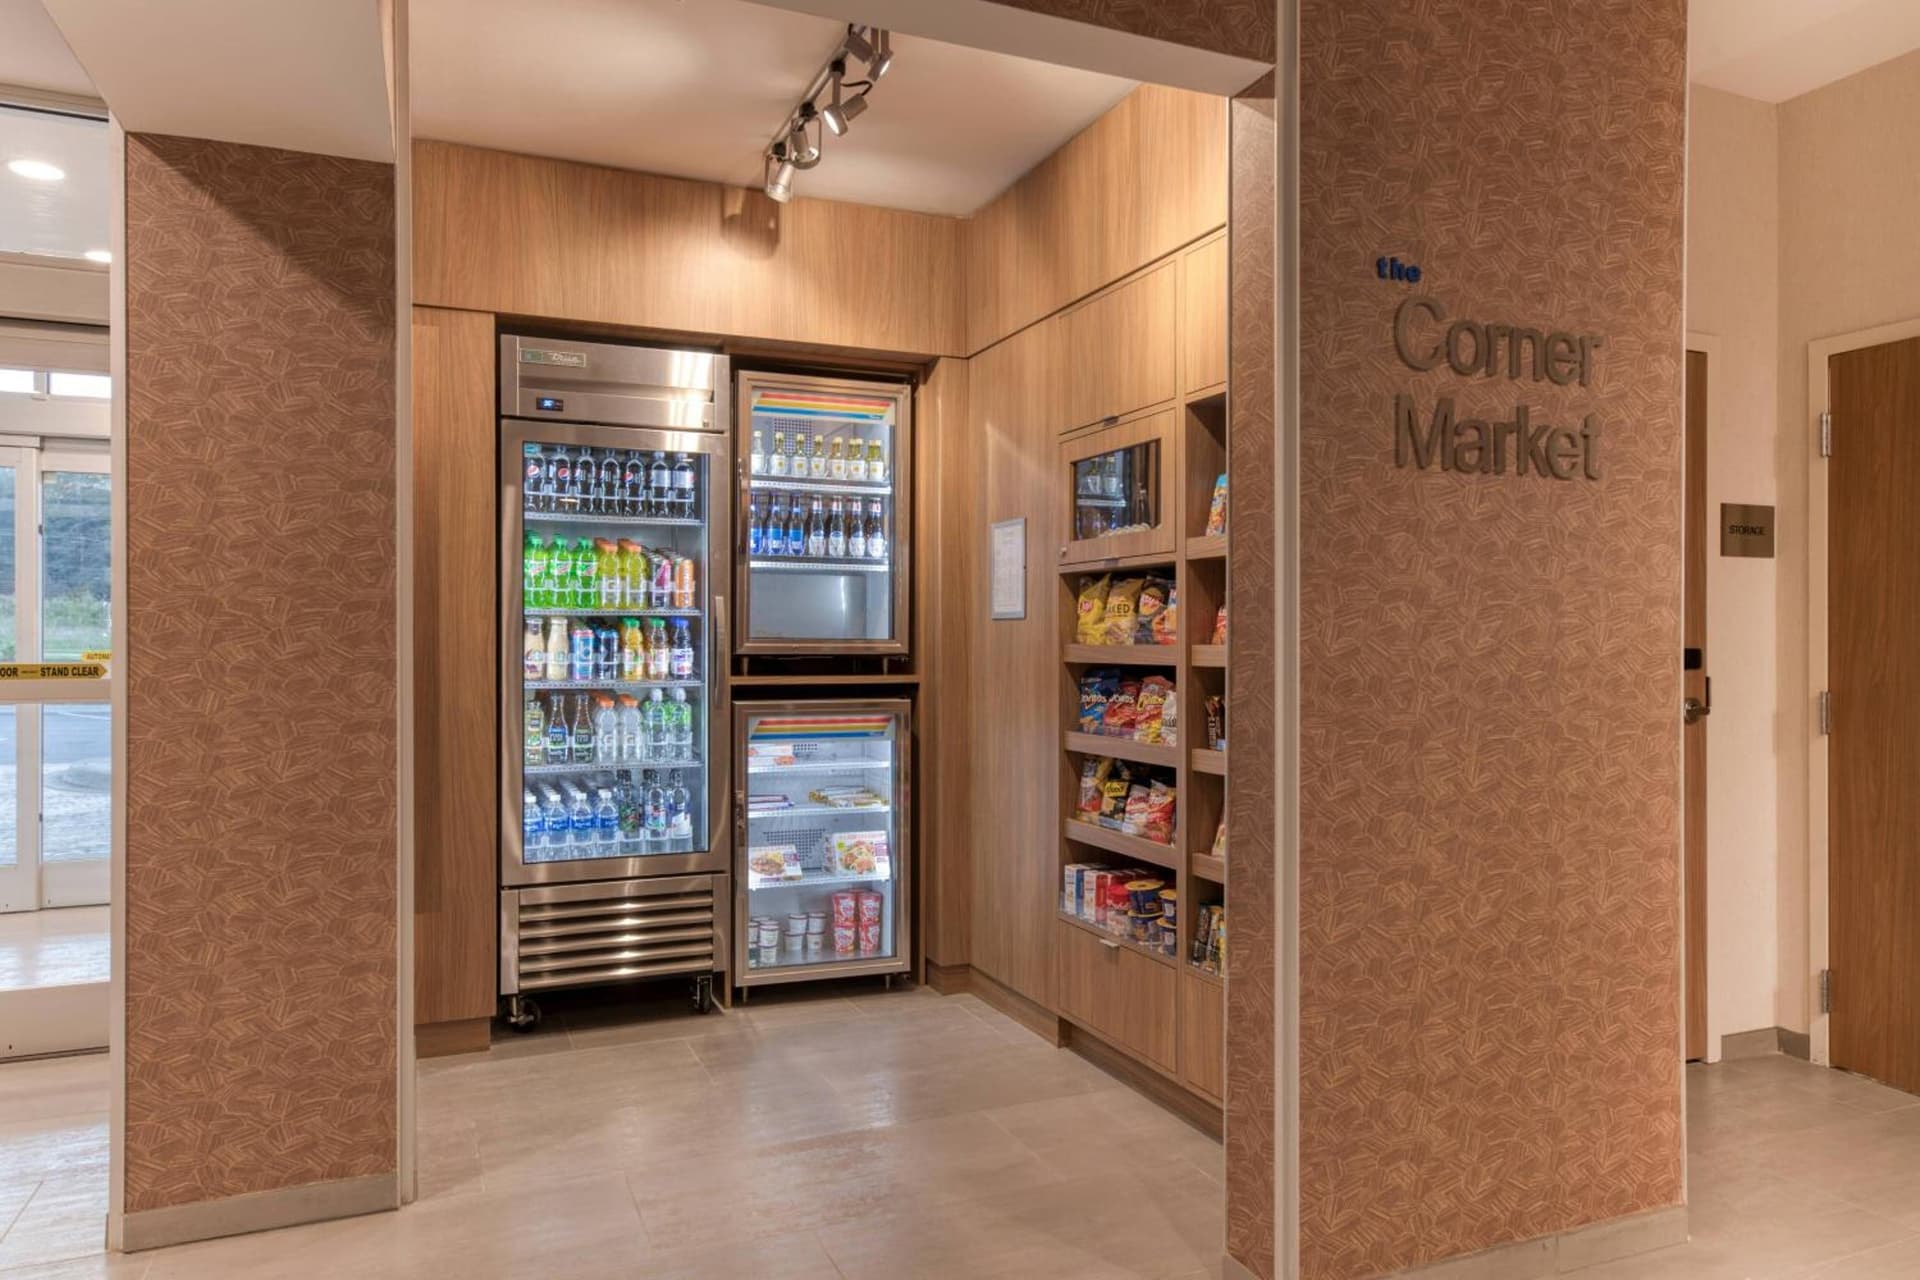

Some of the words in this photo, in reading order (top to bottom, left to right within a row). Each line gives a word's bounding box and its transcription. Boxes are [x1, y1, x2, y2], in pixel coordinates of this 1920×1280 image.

[1376, 256, 1421, 283] the
[1393, 295, 1602, 387] Corner
[1394, 393, 1602, 481] Market
[1728, 525, 1767, 537] STORAGE
[40, 667, 69, 677] STAND
[71, 666, 99, 676] CLEAR
